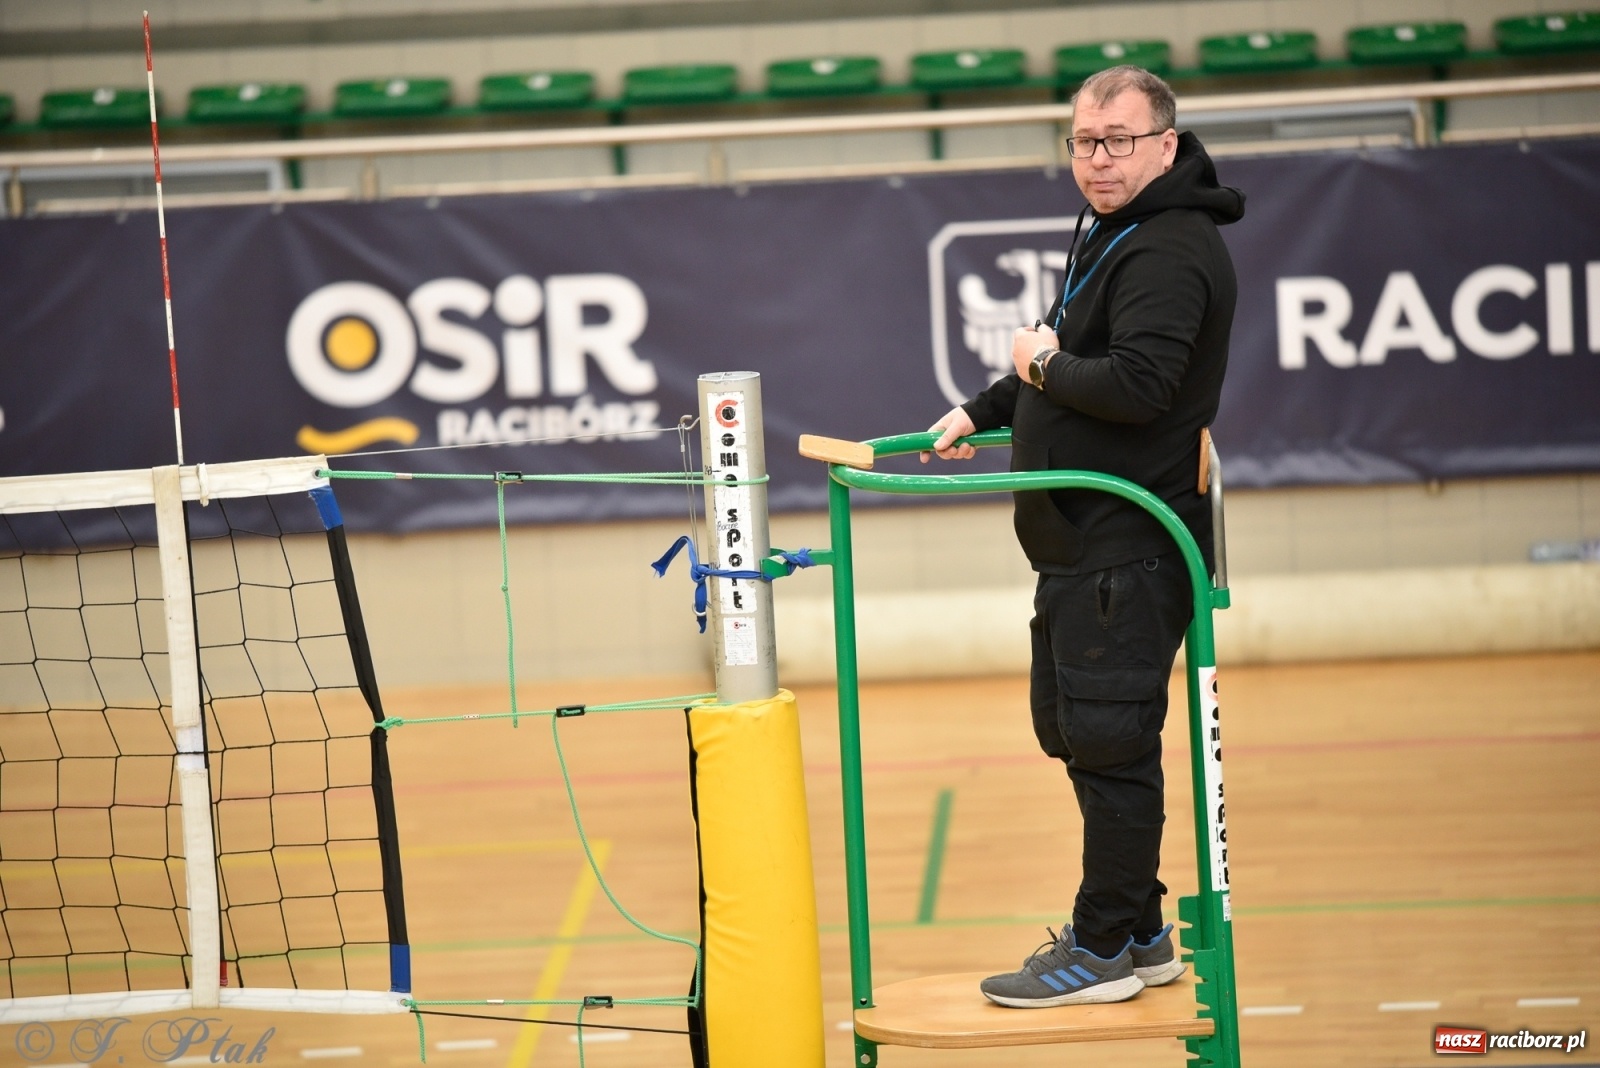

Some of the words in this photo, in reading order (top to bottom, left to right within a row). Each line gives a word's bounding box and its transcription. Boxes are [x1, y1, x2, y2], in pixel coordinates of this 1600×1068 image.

[286, 273, 658, 408] OSiR
[1276, 261, 1600, 370] RACI
[437, 393, 661, 447] RACIBÓRZ
